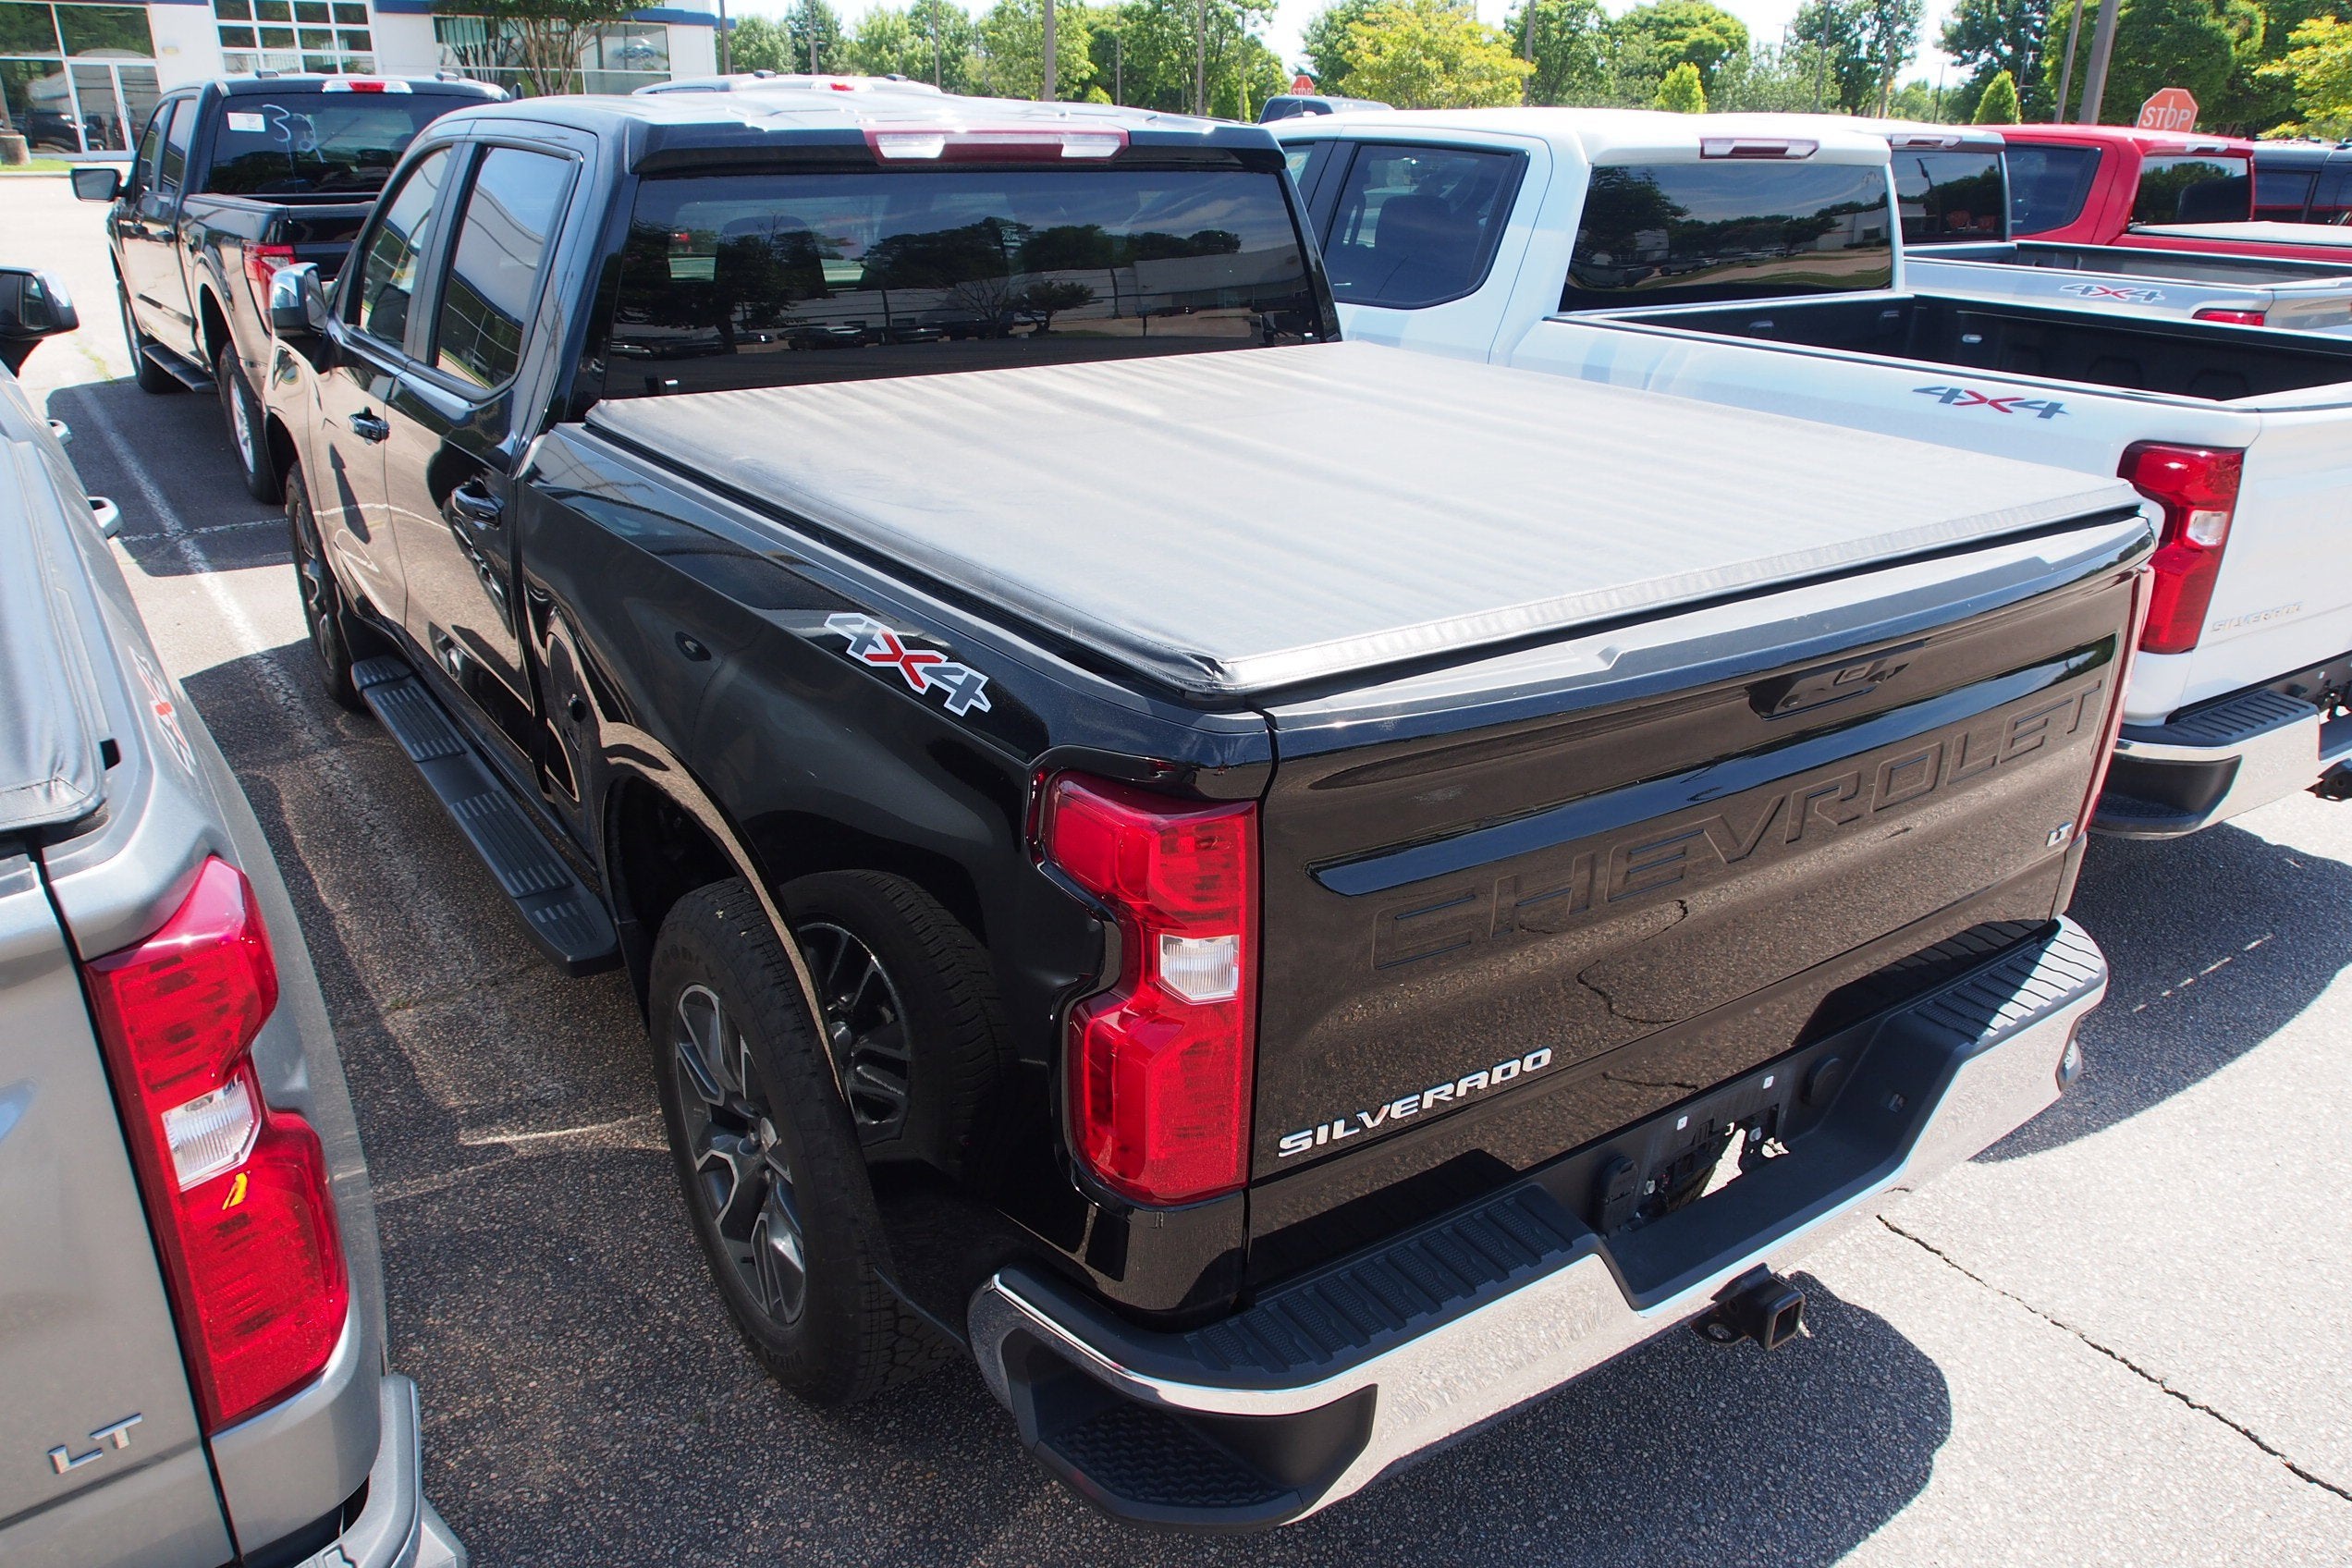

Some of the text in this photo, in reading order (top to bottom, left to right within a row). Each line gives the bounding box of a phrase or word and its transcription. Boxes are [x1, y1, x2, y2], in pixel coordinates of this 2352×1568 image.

[1292, 87, 1313, 95] STOP
[2142, 106, 2191, 130] STOP
[1371, 679, 2101, 971] CHEVROLET
[2045, 821, 2073, 847] LT
[1279, 1047, 1552, 1158] SILVERADO
[47, 1412, 143, 1475] LT
